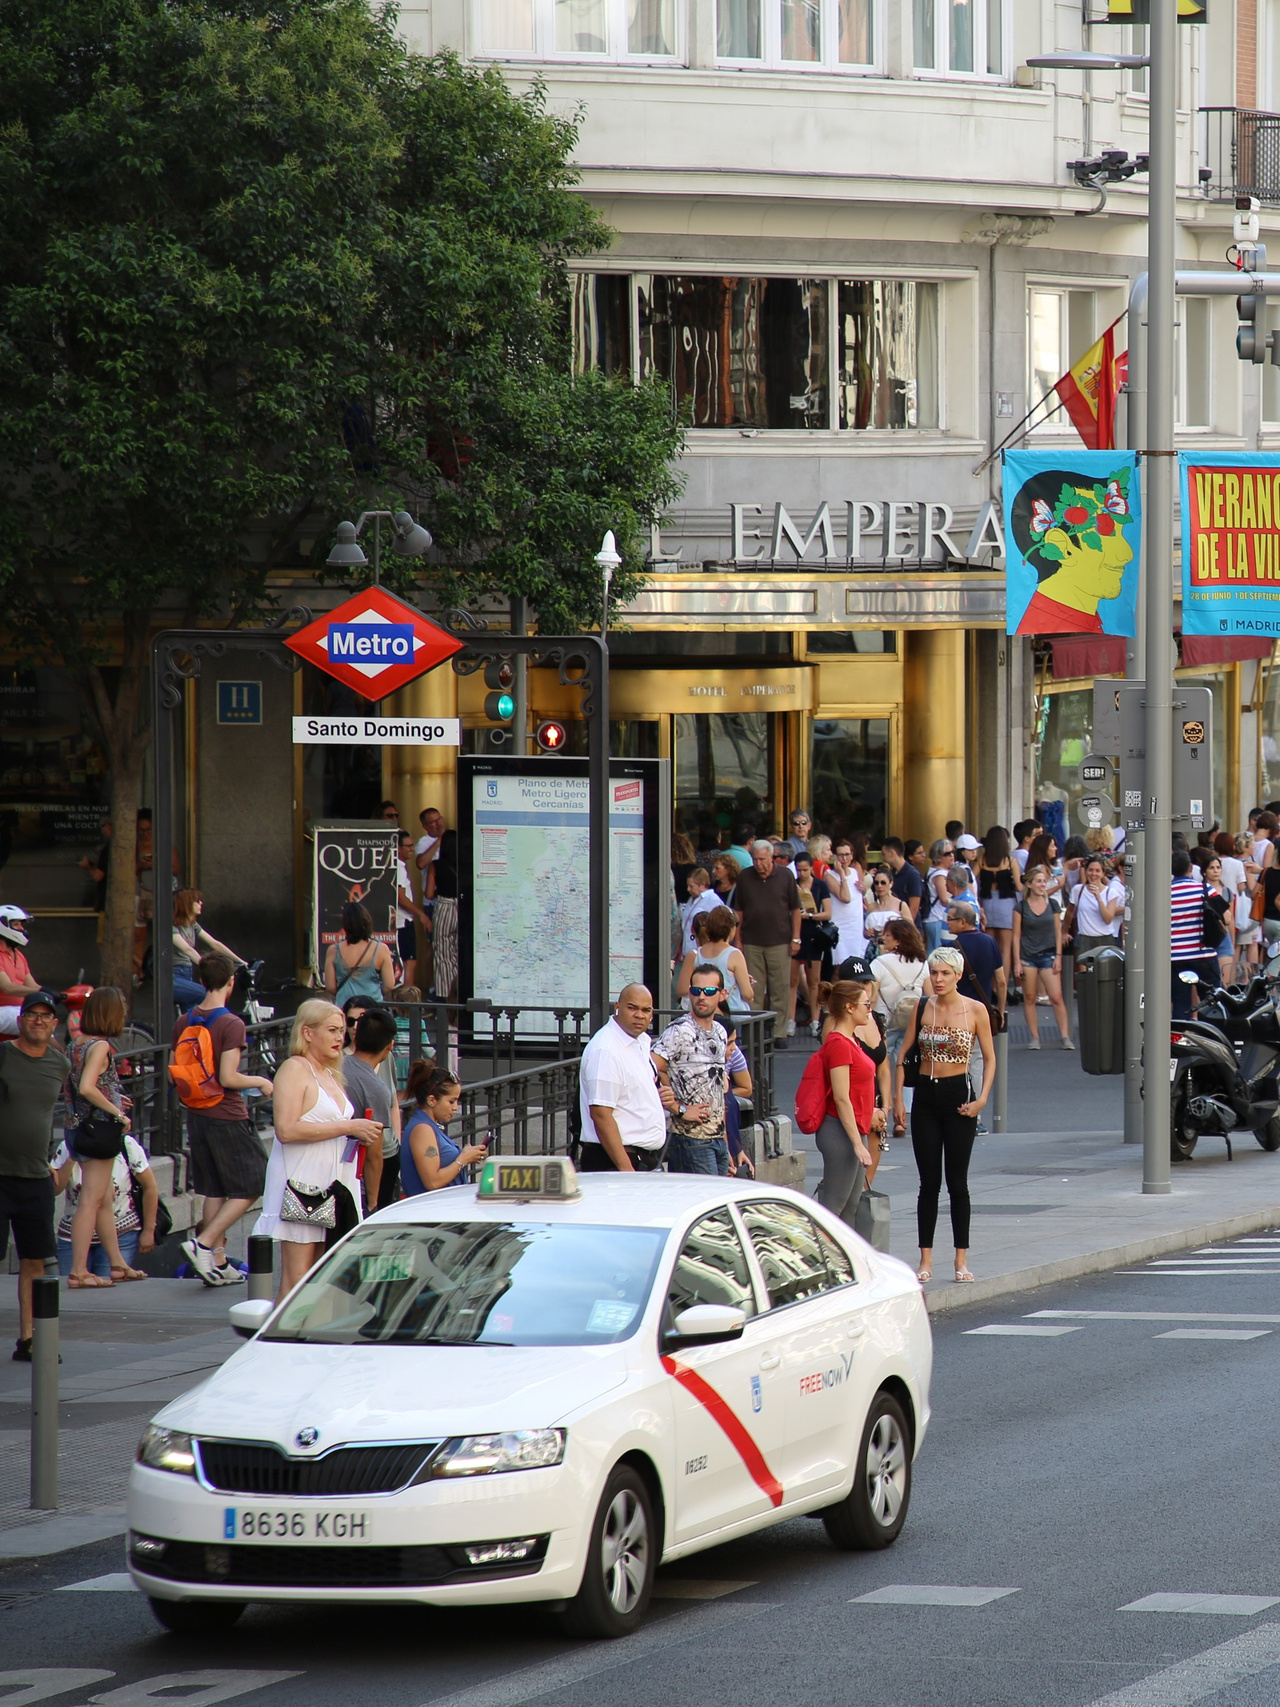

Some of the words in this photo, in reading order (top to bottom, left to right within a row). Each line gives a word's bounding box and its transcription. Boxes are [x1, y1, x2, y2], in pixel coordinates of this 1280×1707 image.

[1197, 532, 1220, 580] DE
[1226, 533, 1249, 579] LA
[1191, 592, 1199, 600] 28
[1201, 592, 1210, 601] DE
[1211, 592, 1231, 600] JUNIO
[1239, 592, 1248, 600] DE
[333, 632, 408, 655] Metro
[688, 686, 727, 697] HOTEL
[740, 685, 796, 696] EMPERADOR
[307, 720, 358, 737] Santo
[364, 721, 445, 742] Domingo
[518, 778, 547, 788] Plano
[550, 779, 562, 788] de
[521, 789, 551, 798] Metro
[554, 789, 587, 800] Ligero
[533, 799, 584, 809] Cercanías
[500, 1168, 540, 1189] TAXI
[242, 1511, 305, 1537] 8636
[315, 1512, 366, 1538] KGH
